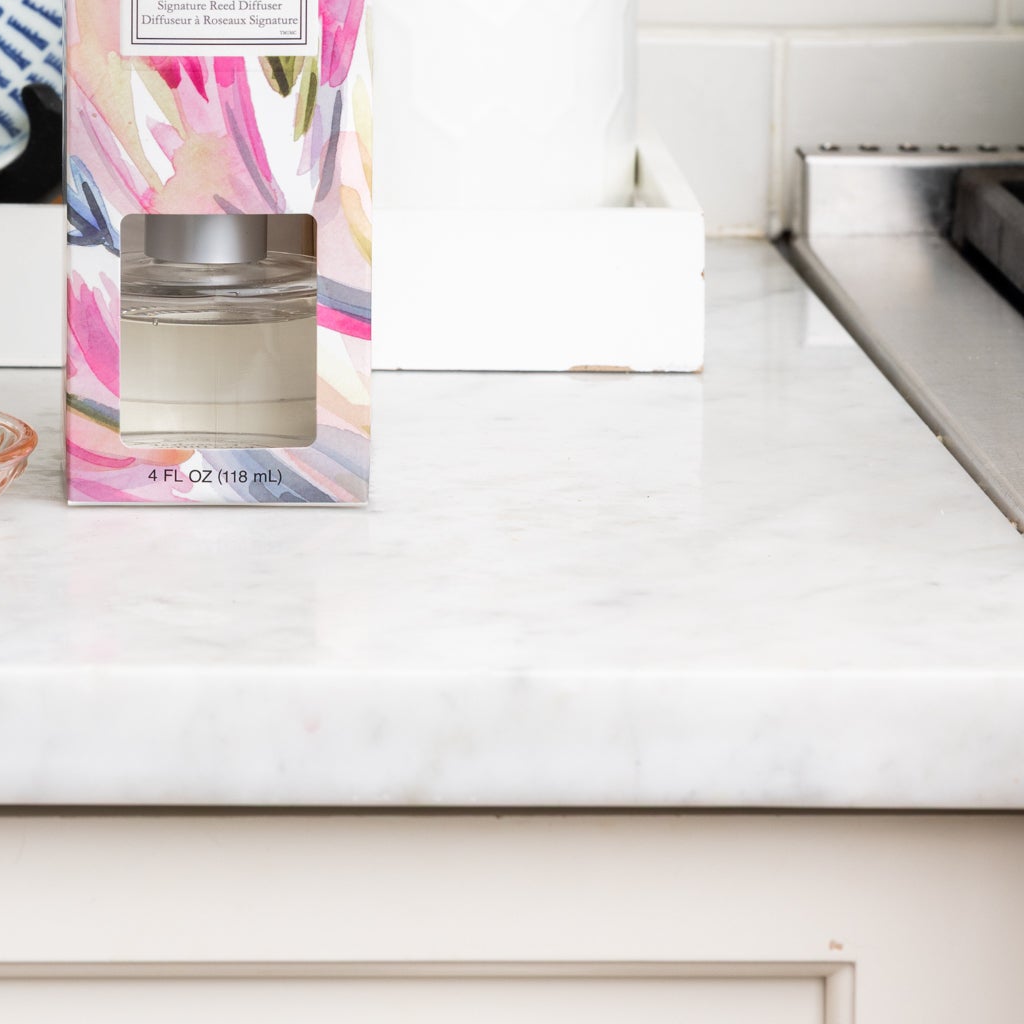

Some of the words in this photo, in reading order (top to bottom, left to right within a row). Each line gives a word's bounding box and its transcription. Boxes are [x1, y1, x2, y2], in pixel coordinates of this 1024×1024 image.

[157, 0, 207, 13] Signature
[209, 0, 236, 11] Reed
[238, 0, 283, 11] Diffuser
[141, 14, 193, 25] Diffuseur
[194, 14, 201, 25] à
[203, 14, 247, 25] Roseaux
[249, 14, 298, 28] Signature
[148, 469, 158, 482] 4
[164, 469, 183, 482] FL
[188, 469, 213, 483] OZ
[217, 469, 248, 485] (118
[253, 469, 282, 485] mL)
